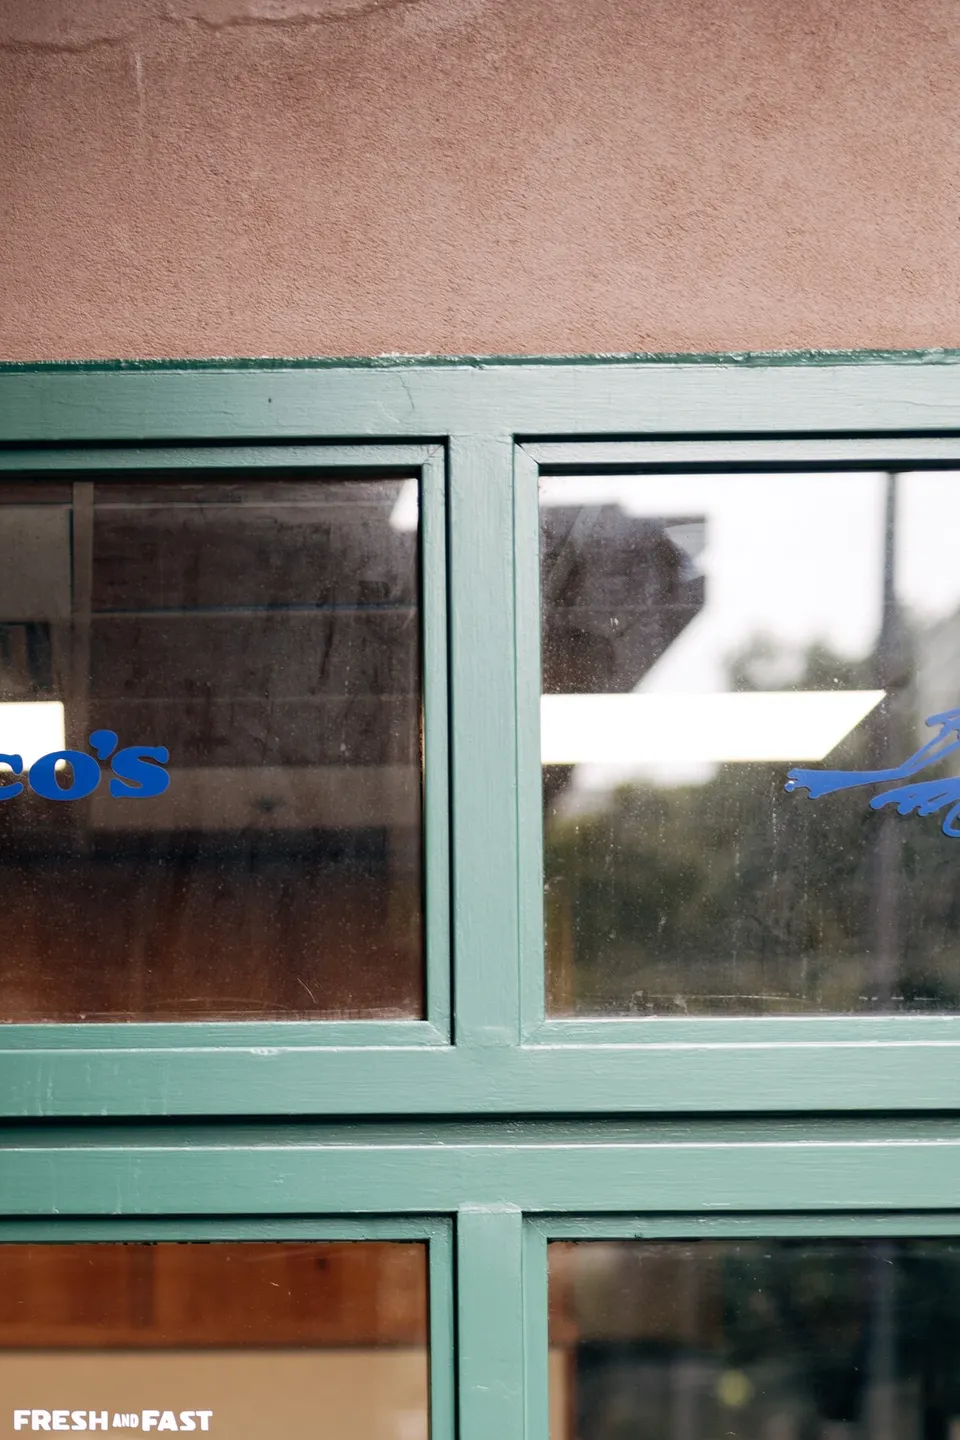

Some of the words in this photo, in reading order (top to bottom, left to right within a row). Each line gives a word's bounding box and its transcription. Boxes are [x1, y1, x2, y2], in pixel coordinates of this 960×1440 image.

[13, 1409, 109, 1431] FRESH
[112, 1413, 139, 1428] AND
[141, 1410, 213, 1432] FAST
